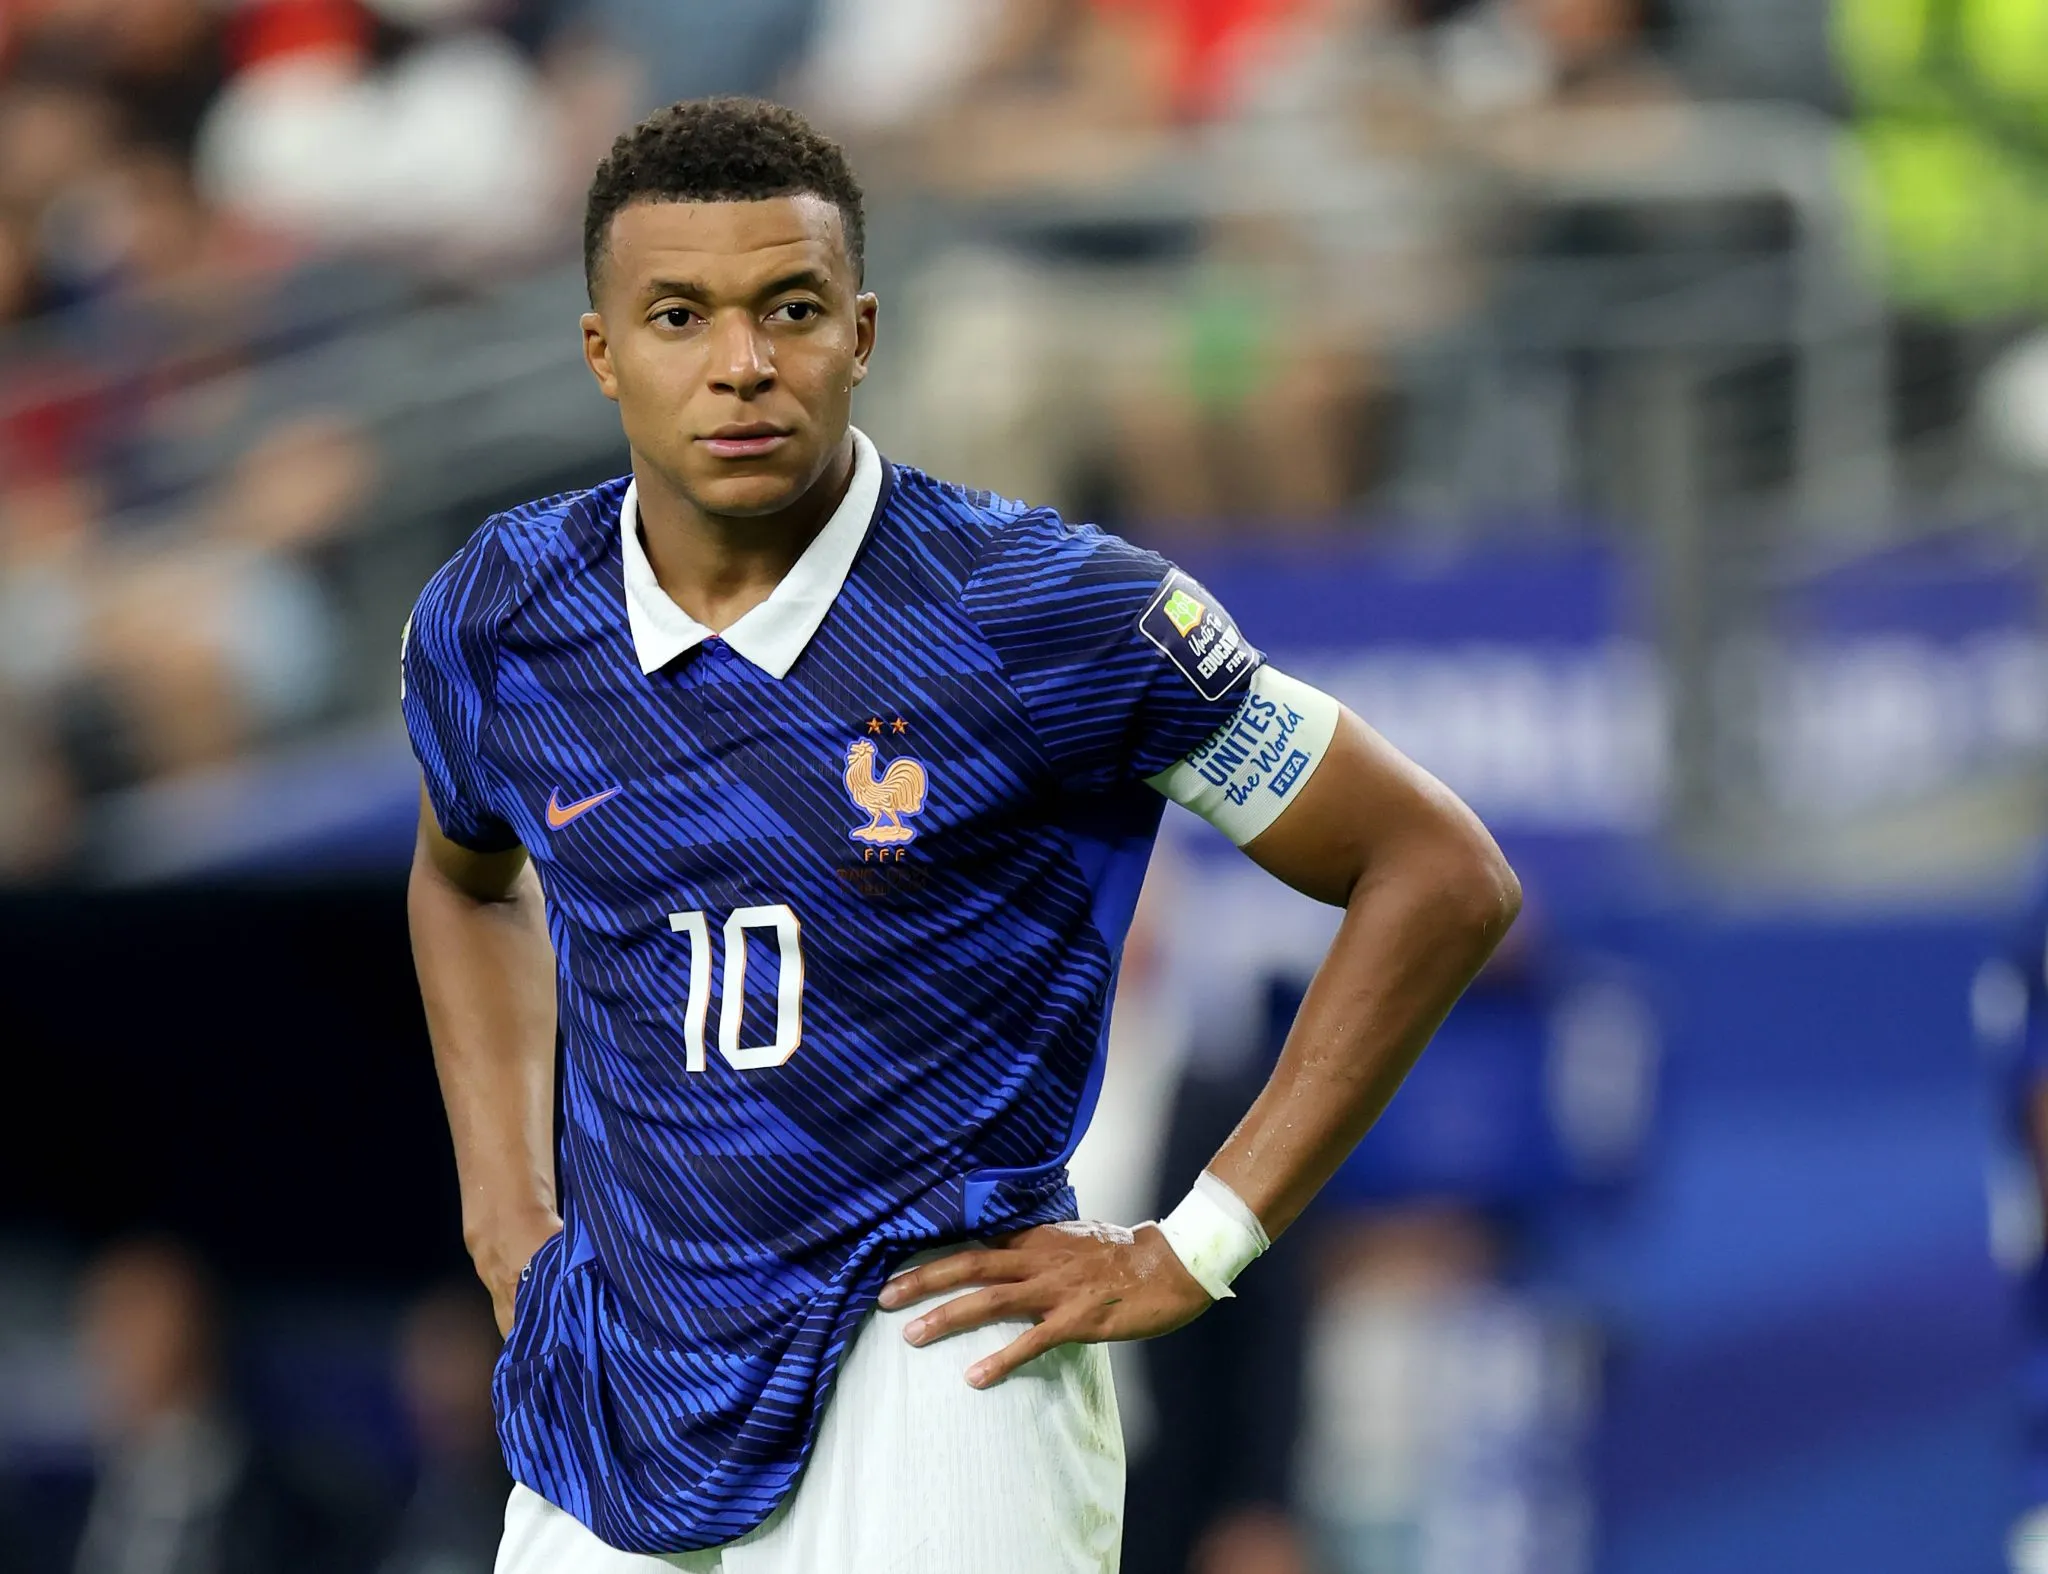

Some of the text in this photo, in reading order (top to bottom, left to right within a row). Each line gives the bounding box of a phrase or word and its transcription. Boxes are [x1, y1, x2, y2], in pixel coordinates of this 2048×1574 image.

[1225, 650, 1247, 673] FIFA
[1185, 689, 1251, 769] FOOT
[1198, 694, 1277, 787] UNITES
[1224, 703, 1305, 806] the World
[1272, 754, 1306, 793] FIFA
[668, 904, 805, 1072] 10
